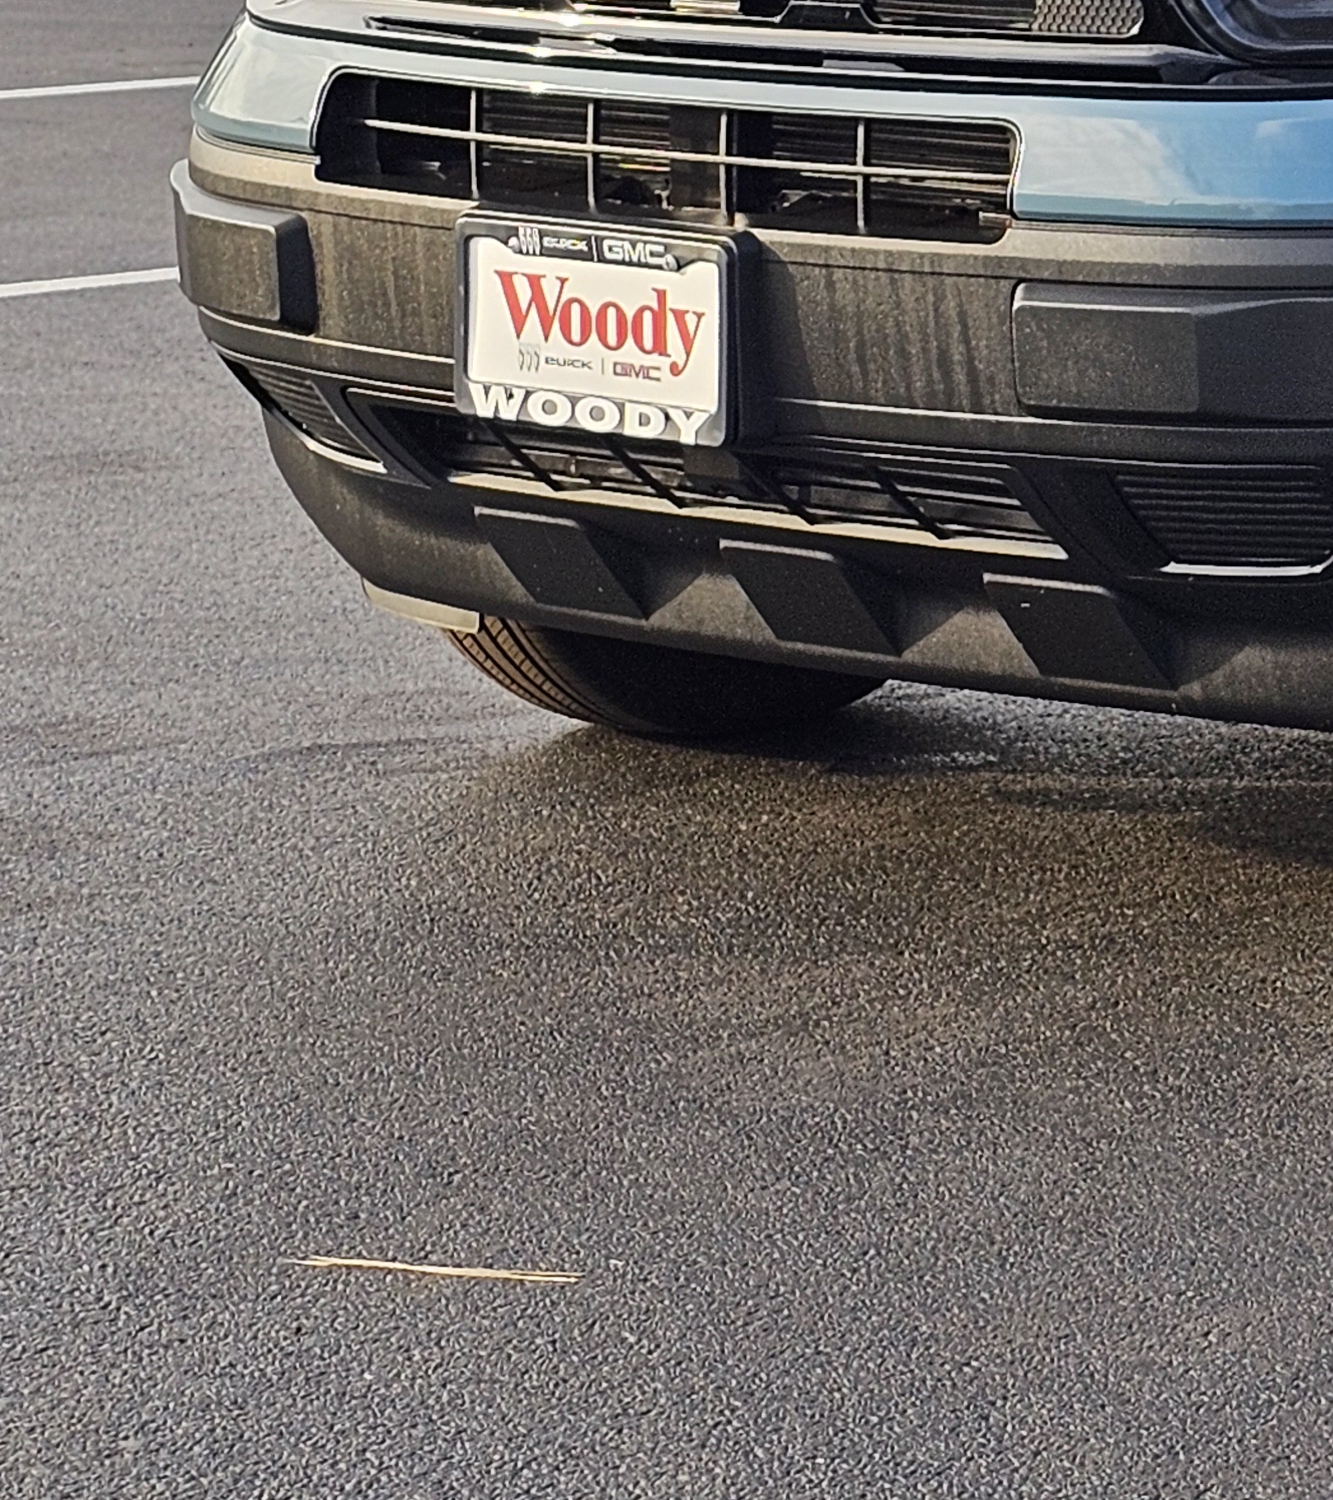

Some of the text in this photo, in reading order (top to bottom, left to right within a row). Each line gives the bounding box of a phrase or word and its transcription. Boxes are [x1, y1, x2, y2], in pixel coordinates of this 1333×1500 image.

[602, 238, 666, 265] GMC
[493, 269, 706, 378] Woody
[612, 361, 662, 383] GMC
[468, 382, 714, 446] WOODY
